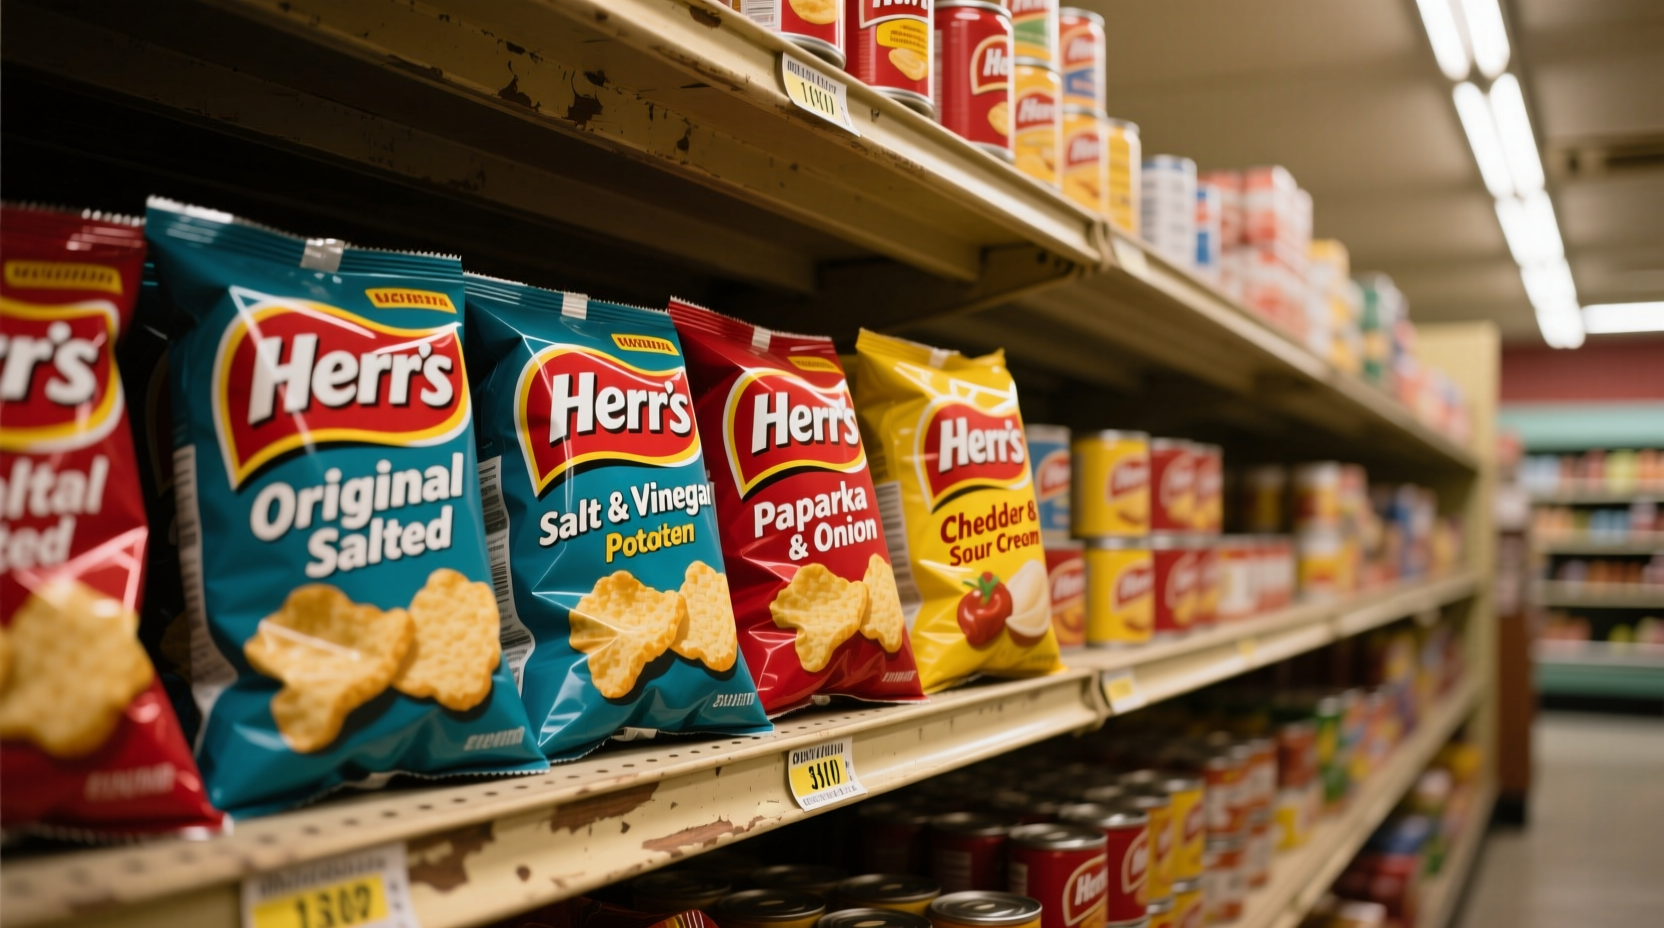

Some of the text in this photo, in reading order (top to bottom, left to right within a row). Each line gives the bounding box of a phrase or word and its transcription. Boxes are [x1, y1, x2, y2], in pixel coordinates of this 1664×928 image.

[248, 333, 454, 425] Herr's
[549, 372, 692, 443] Herr's
[752, 391, 860, 454] Herr's
[938, 416, 1025, 474] Herr's
[250, 452, 464, 541] Original
[539, 498, 602, 547] Salt
[607, 491, 630, 523] &
[754, 481, 868, 538] Paparka
[940, 499, 1037, 545] Chedder &
[304, 505, 454, 578] Salted
[788, 514, 878, 560] & Onion
[949, 541, 993, 567] Sour
